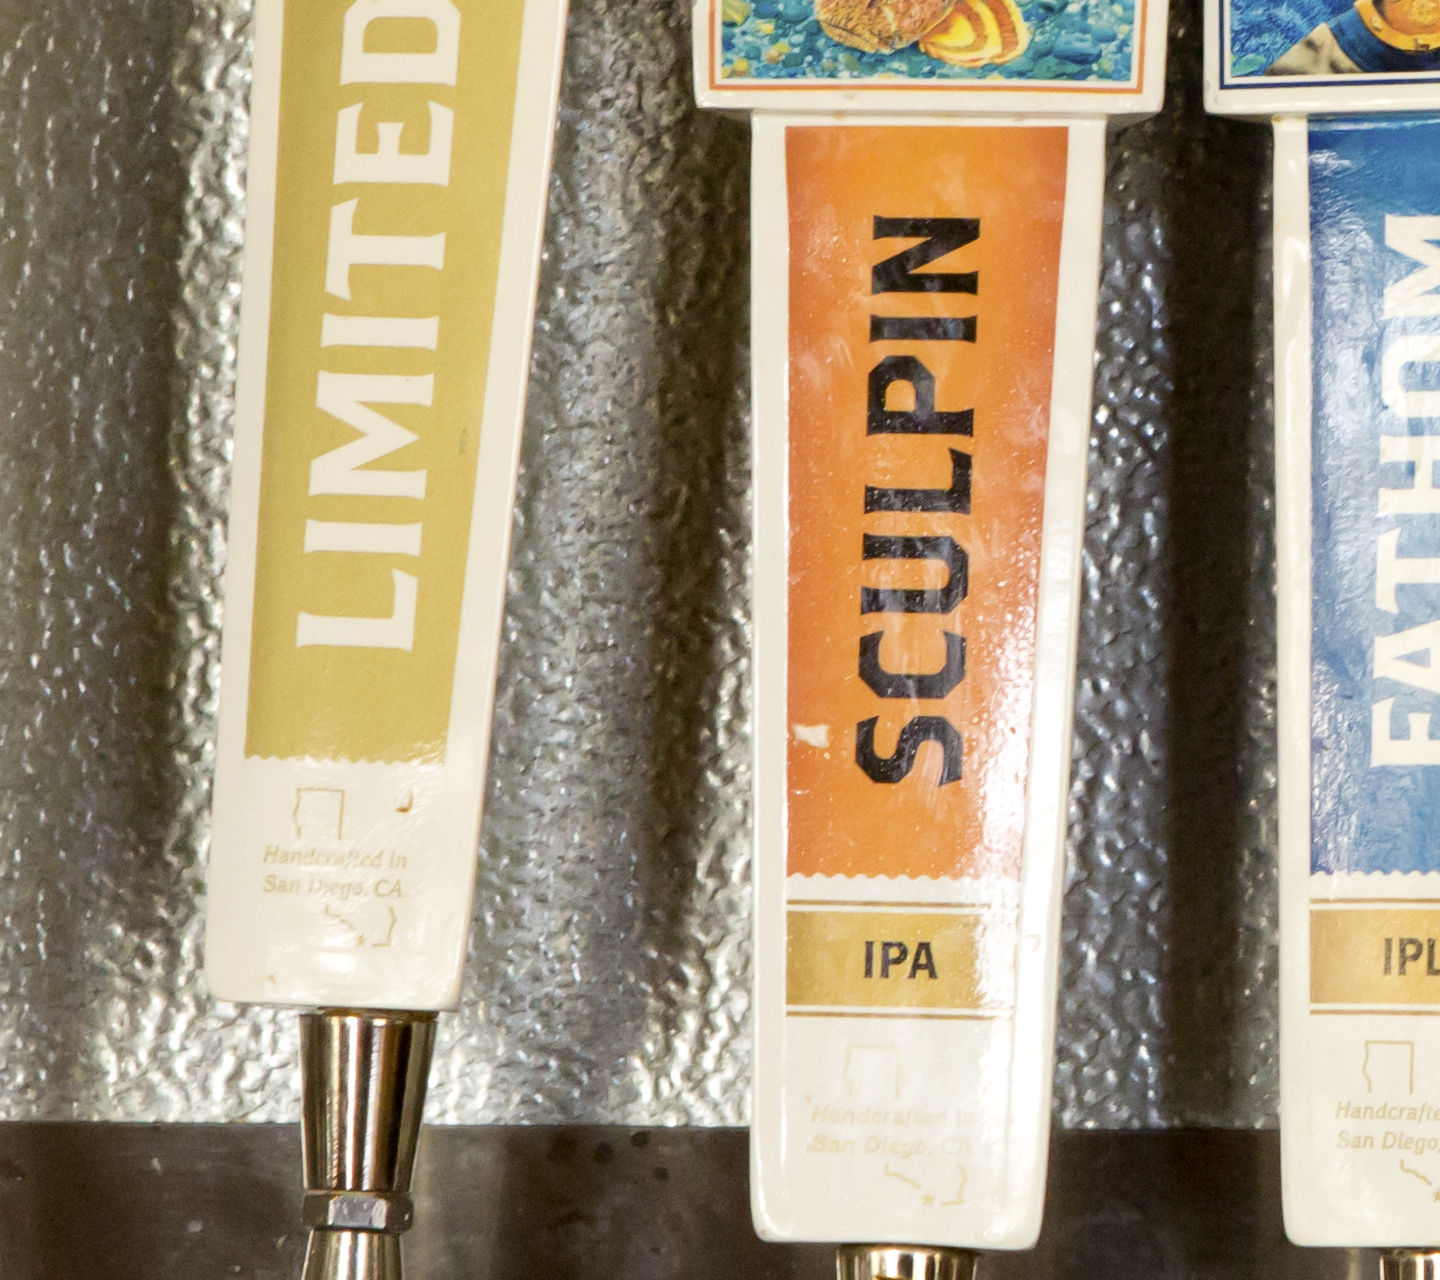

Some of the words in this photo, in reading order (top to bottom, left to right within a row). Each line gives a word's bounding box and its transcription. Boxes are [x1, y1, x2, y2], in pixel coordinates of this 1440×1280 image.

[854, 213, 981, 791] SCULPIN
[863, 940, 939, 982] IPA
[1337, 1131, 1374, 1149] San
